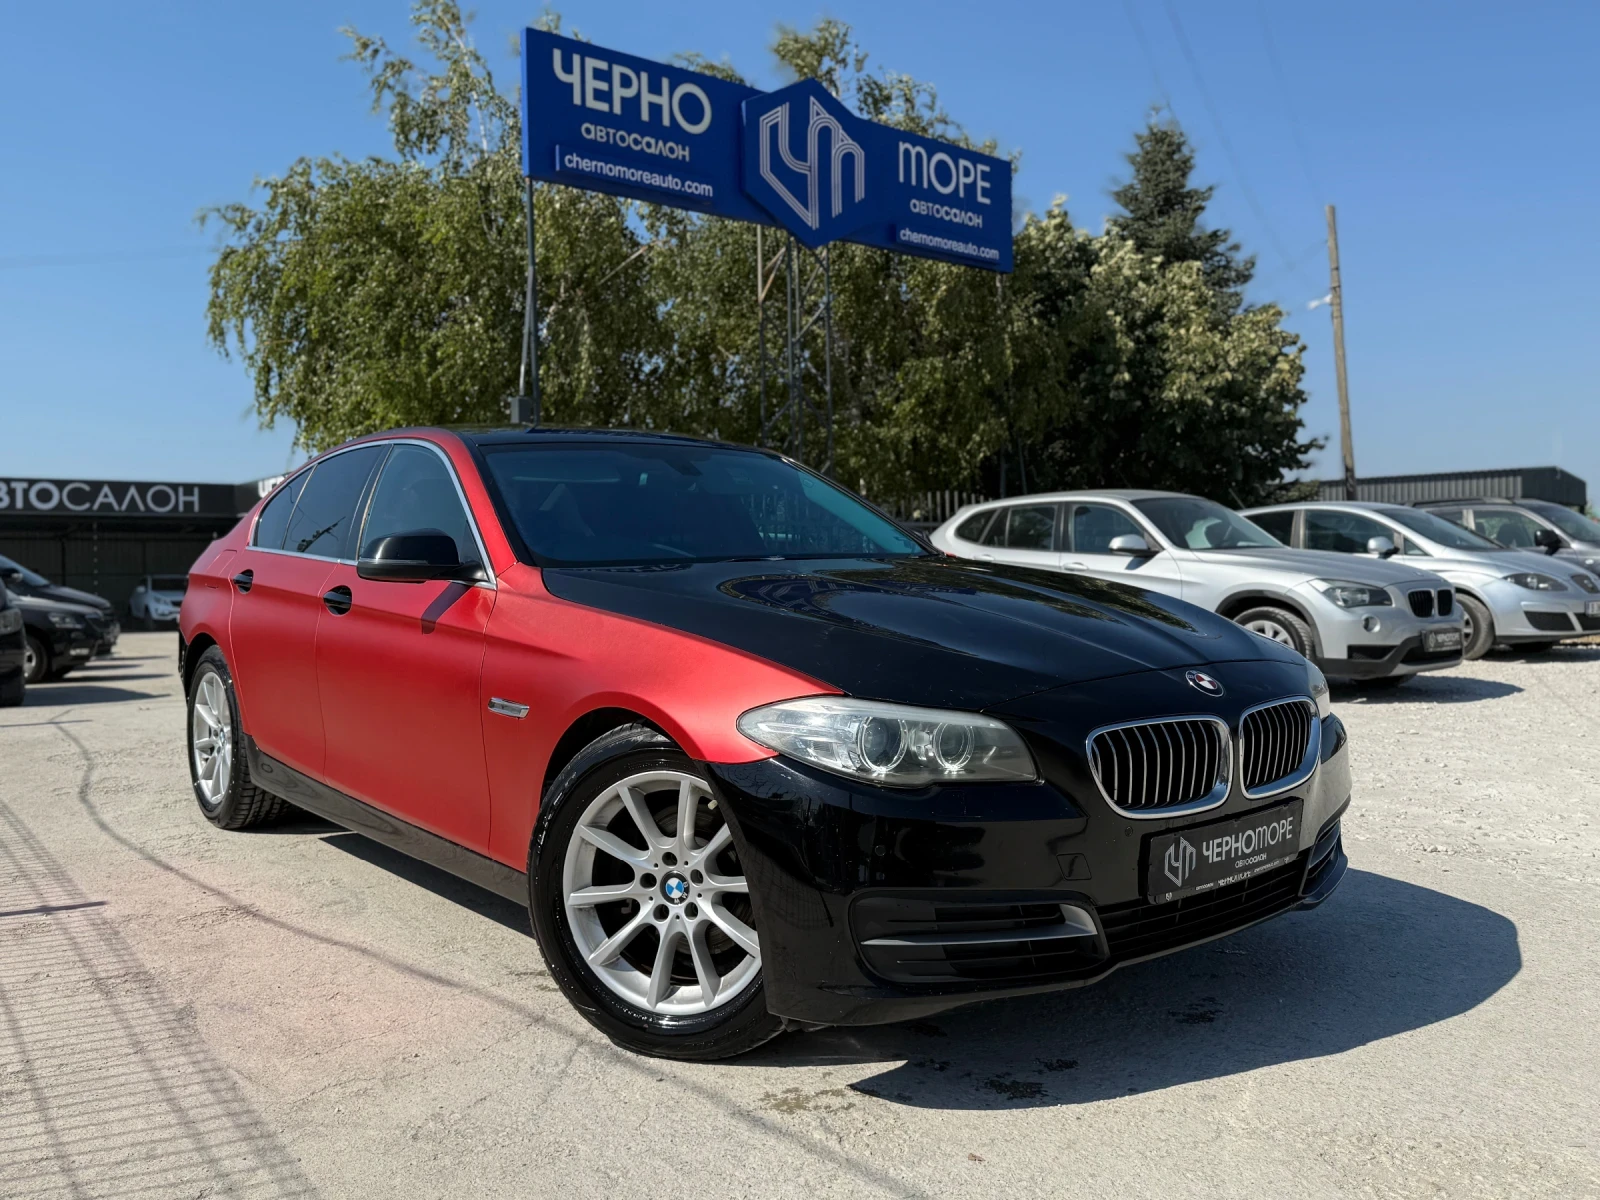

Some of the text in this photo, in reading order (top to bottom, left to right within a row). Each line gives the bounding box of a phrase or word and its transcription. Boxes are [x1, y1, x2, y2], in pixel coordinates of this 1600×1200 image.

[553, 48, 712, 134] ЧЕРНО
[564, 153, 713, 197] chernomoreauto.com
[900, 228, 999, 260] chernomoreauto.com
[1202, 816, 1293, 863] ЧЕРНОМОРЕ
